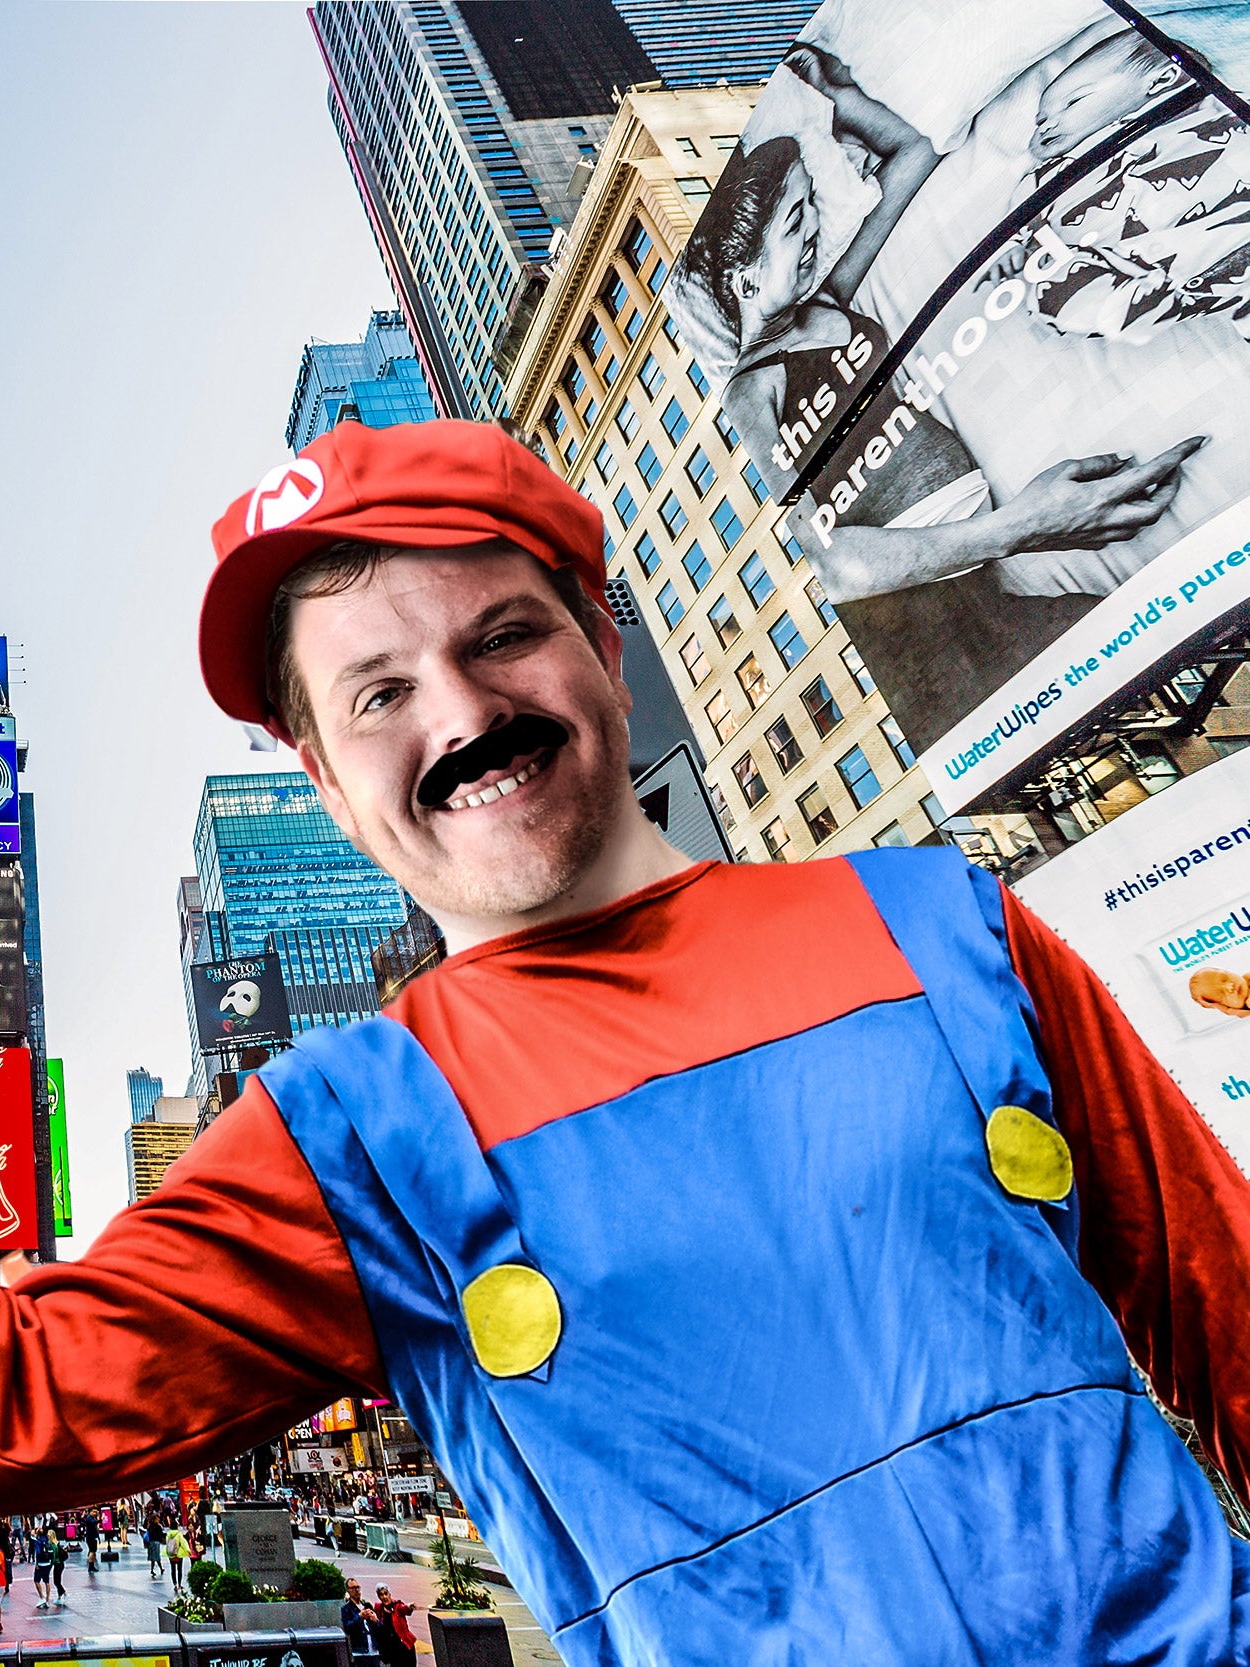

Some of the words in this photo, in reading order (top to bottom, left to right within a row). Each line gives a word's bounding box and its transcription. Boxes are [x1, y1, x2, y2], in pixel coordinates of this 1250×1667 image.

[771, 383, 837, 472] this
[831, 331, 873, 382] is
[254, 469, 318, 535] M
[945, 680, 1062, 780] WaterWipes
[1064, 656, 1100, 687] the
[1099, 597, 1177, 659] world's
[206, 962, 266, 979] PHANTOM
[288, 1428, 313, 1440] OPEN
